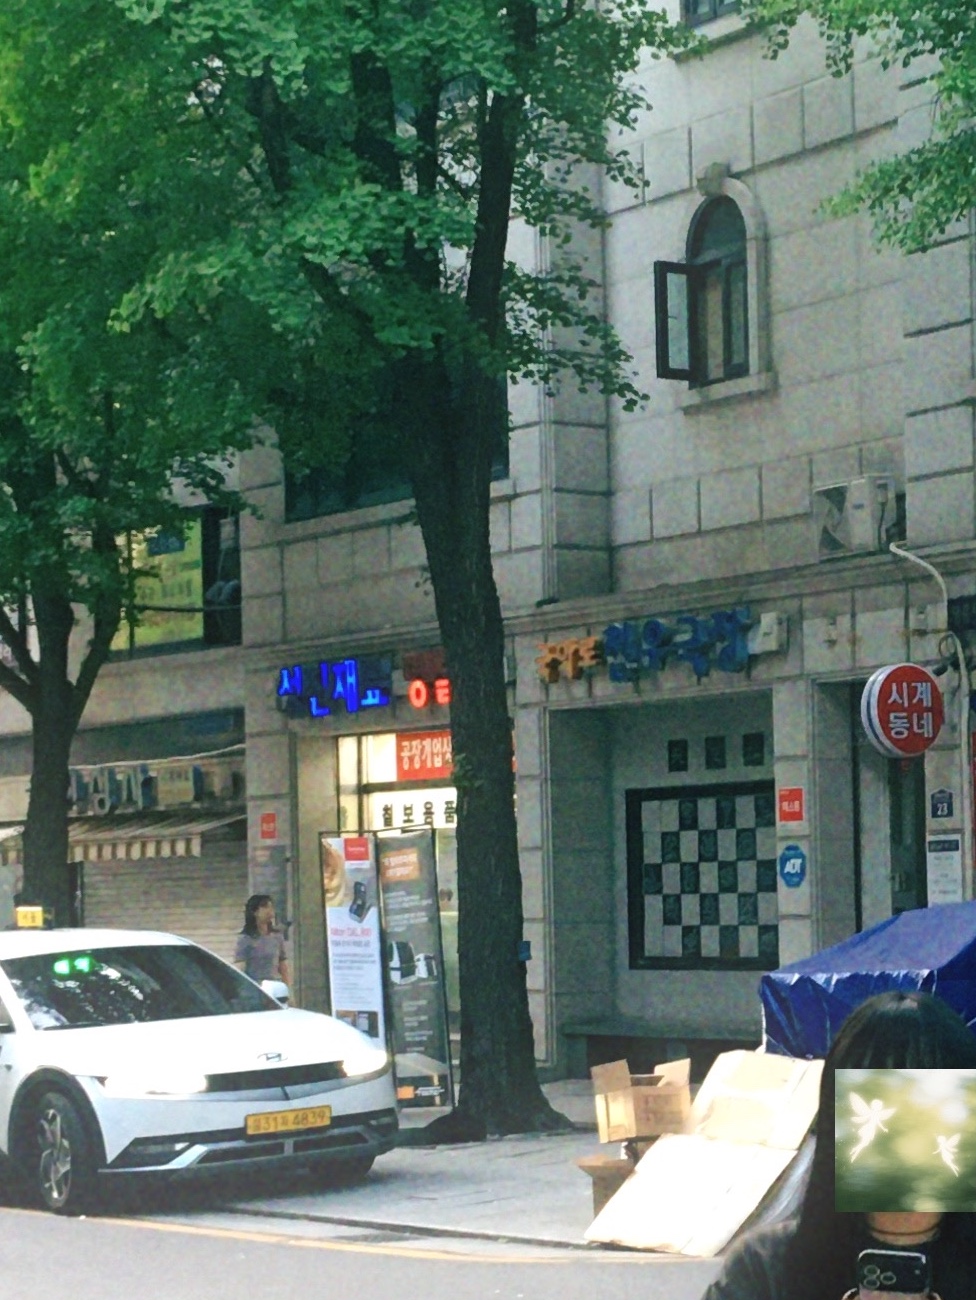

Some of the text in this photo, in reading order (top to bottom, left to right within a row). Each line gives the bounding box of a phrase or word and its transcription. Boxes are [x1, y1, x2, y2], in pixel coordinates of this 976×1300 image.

[888, 682, 932, 708] 시계
[889, 712, 933, 739] 동네
[784, 859, 803, 874] ADT
